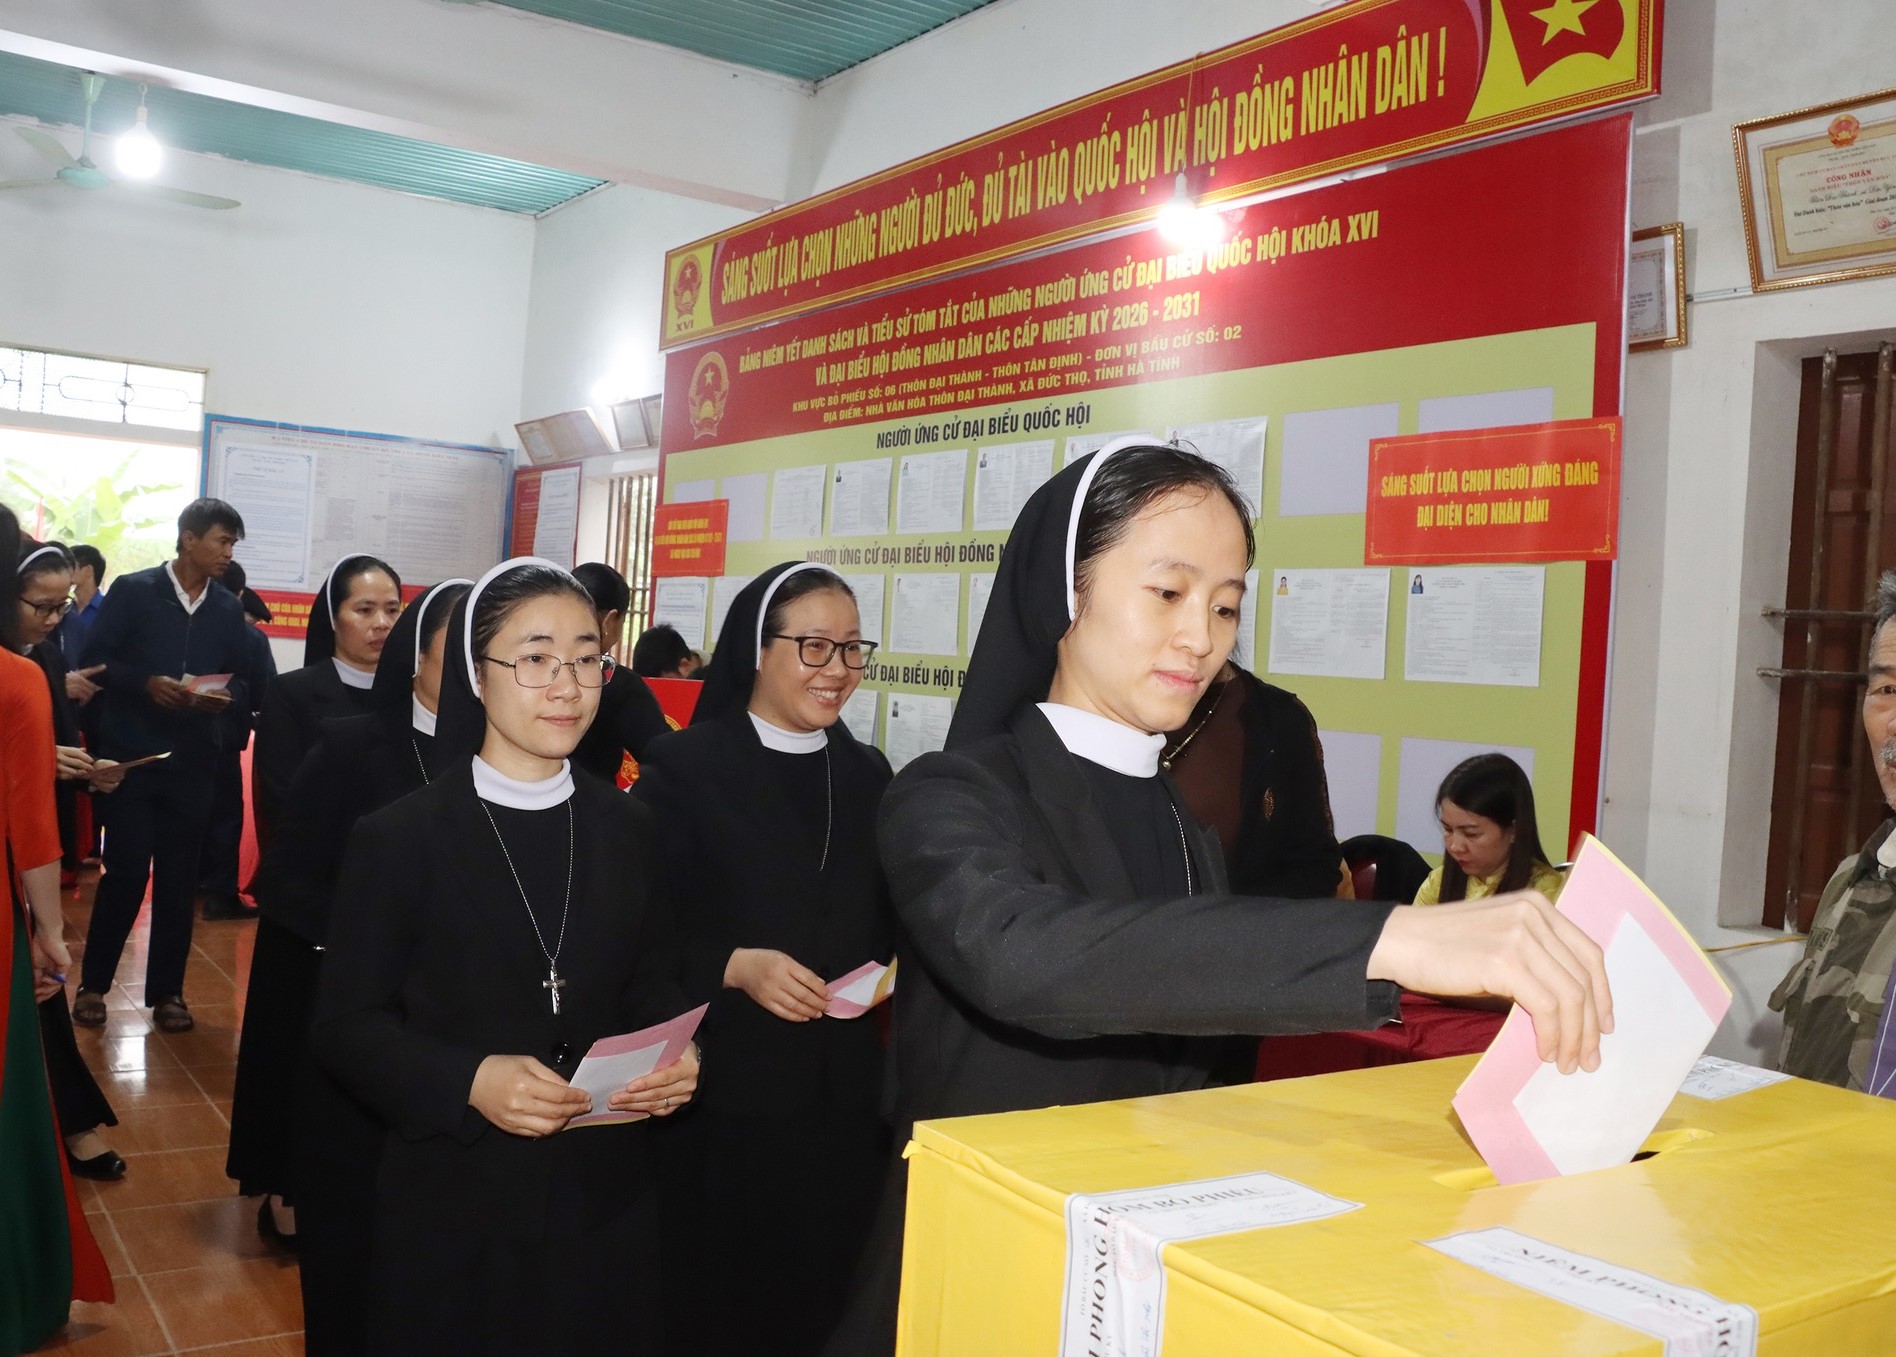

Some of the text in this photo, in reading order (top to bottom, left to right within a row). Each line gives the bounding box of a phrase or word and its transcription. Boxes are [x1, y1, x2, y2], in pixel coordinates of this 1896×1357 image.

[722, 252, 749, 304] SÁNG
[750, 232, 777, 296] SUỐT
[778, 236, 798, 296] LỰA
[801, 228, 833, 287] CHỌN
[834, 210, 877, 271] NHỮNG
[879, 188, 920, 257] NGƯỜI
[923, 173, 943, 245] ĐỦ
[945, 172, 977, 236] ĐỨC,
[982, 152, 1004, 227] ĐỦ
[1008, 151, 1033, 219] TÀI
[1037, 140, 1069, 210] VÀO
[1074, 112, 1120, 205] QUỐC
[1125, 108, 1158, 194] HỘI
[1163, 98, 1187, 174] VÀ
[1193, 86, 1228, 176] HỘI
[1234, 64, 1294, 156] ĐỒNG
[1300, 44, 1368, 136] NHÂN
[1375, 24, 1429, 114] DÂN
[740, 347, 761, 373] BẢNG
[763, 344, 784, 367] NIÊM
[786, 336, 802, 362] YẾT
[802, 335, 827, 358] DANH
[829, 328, 854, 352] SÁCH
[857, 322, 868, 346] VÀ
[872, 313, 893, 343] TIỂU
[896, 307, 912, 337] SỬ
[913, 307, 936, 334] TÓM
[939, 299, 960, 328] TẮT
[962, 292, 985, 323] CỦA
[988, 286, 1031, 318] NHỮNG
[1035, 274, 1076, 308] NGƯỜI
[1080, 268, 1108, 298] ỨNG
[1113, 255, 1135, 292] CỬ
[1136, 258, 1162, 289] ĐẠI
[1206, 231, 1252, 274] QUỐC
[1256, 226, 1286, 264] HỘI
[1291, 216, 1341, 254] KHÓA
[1347, 210, 1379, 243] XVI
[676, 320, 694, 331] XVI
[816, 362, 827, 386] VÀ
[829, 362, 845, 386] ĐẠI
[848, 351, 869, 380] BIỂU
[872, 350, 889, 378] HỘI
[892, 343, 921, 371] ĐỒNG
[924, 337, 956, 365] NHÂN
[958, 332, 982, 360] DÂN
[986, 326, 1010, 354] CÁC
[1013, 316, 1039, 349] CẤP
[1042, 311, 1087, 344] NHIỆM
[1090, 304, 1110, 335] KỲ
[1112, 302, 1149, 330] 2026
[1163, 291, 1200, 321] 2031
[793, 401, 808, 412] KHU
[811, 397, 825, 410] VỰC
[828, 391, 838, 406] BỎ
[841, 386, 866, 404] PHIẾU
[868, 384, 882, 399] SỐ:
[885, 385, 896, 397] 06
[899, 378, 926, 394] (THÔN
[929, 374, 946, 389] ĐẠI
[949, 369, 982, 384] THÀNH
[992, 363, 1021, 378] THÔN
[1024, 359, 1046, 372] TÂN
[1050, 352, 1082, 370] ĐỊNH)
[1095, 347, 1121, 362] ĐƠN
[1125, 342, 1137, 358] VỊ
[1142, 336, 1168, 353] BẦU
[1173, 329, 1193, 349] CỬ
[1196, 324, 1219, 344] SỐ:
[1224, 325, 1242, 340] 02
[824, 410, 837, 424] ĐỊA
[839, 405, 863, 420] ĐIỂM:
[866, 402, 884, 415] NHÀ
[886, 398, 904, 412] VĂN
[907, 396, 926, 410] HÓA
[929, 392, 955, 406] THÔN
[958, 389, 974, 403] ĐẠI
[1020, 378, 1034, 392] XÃ
[1038, 373, 1061, 389] ĐỨC
[1065, 371, 1090, 386] THỌ,
[1095, 362, 1124, 381] TỈNH
[1128, 360, 1145, 376] HÀ
[1150, 356, 1180, 373] TĨNH
[877, 401, 1091, 449] NGƯỜI ỨNG CỬ ĐẠI BIỂU QUỐC HỘI
[1381, 459, 1598, 497] SÁNG SUỐT LỰA CHỌN NGƯỜI XỨNG ĐÁNG
[1417, 496, 1549, 530] ĐẠI DIỆN CHO NHÂN DÂN!
[806, 545, 836, 565] NGƯỜI
[840, 544, 861, 565] ỨNG
[864, 541, 880, 564] CỬ
[882, 547, 900, 567] ĐẠI
[904, 539, 931, 563] BIỂU
[935, 542, 955, 567] HỘI
[959, 538, 994, 562] ĐỒNG
[863, 657, 881, 680] CỬ
[880, 665, 899, 686] ĐẠI
[903, 660, 929, 685] BIỂU
[933, 666, 954, 690] HỘI
[1090, 1234, 1108, 1342] PHONG
